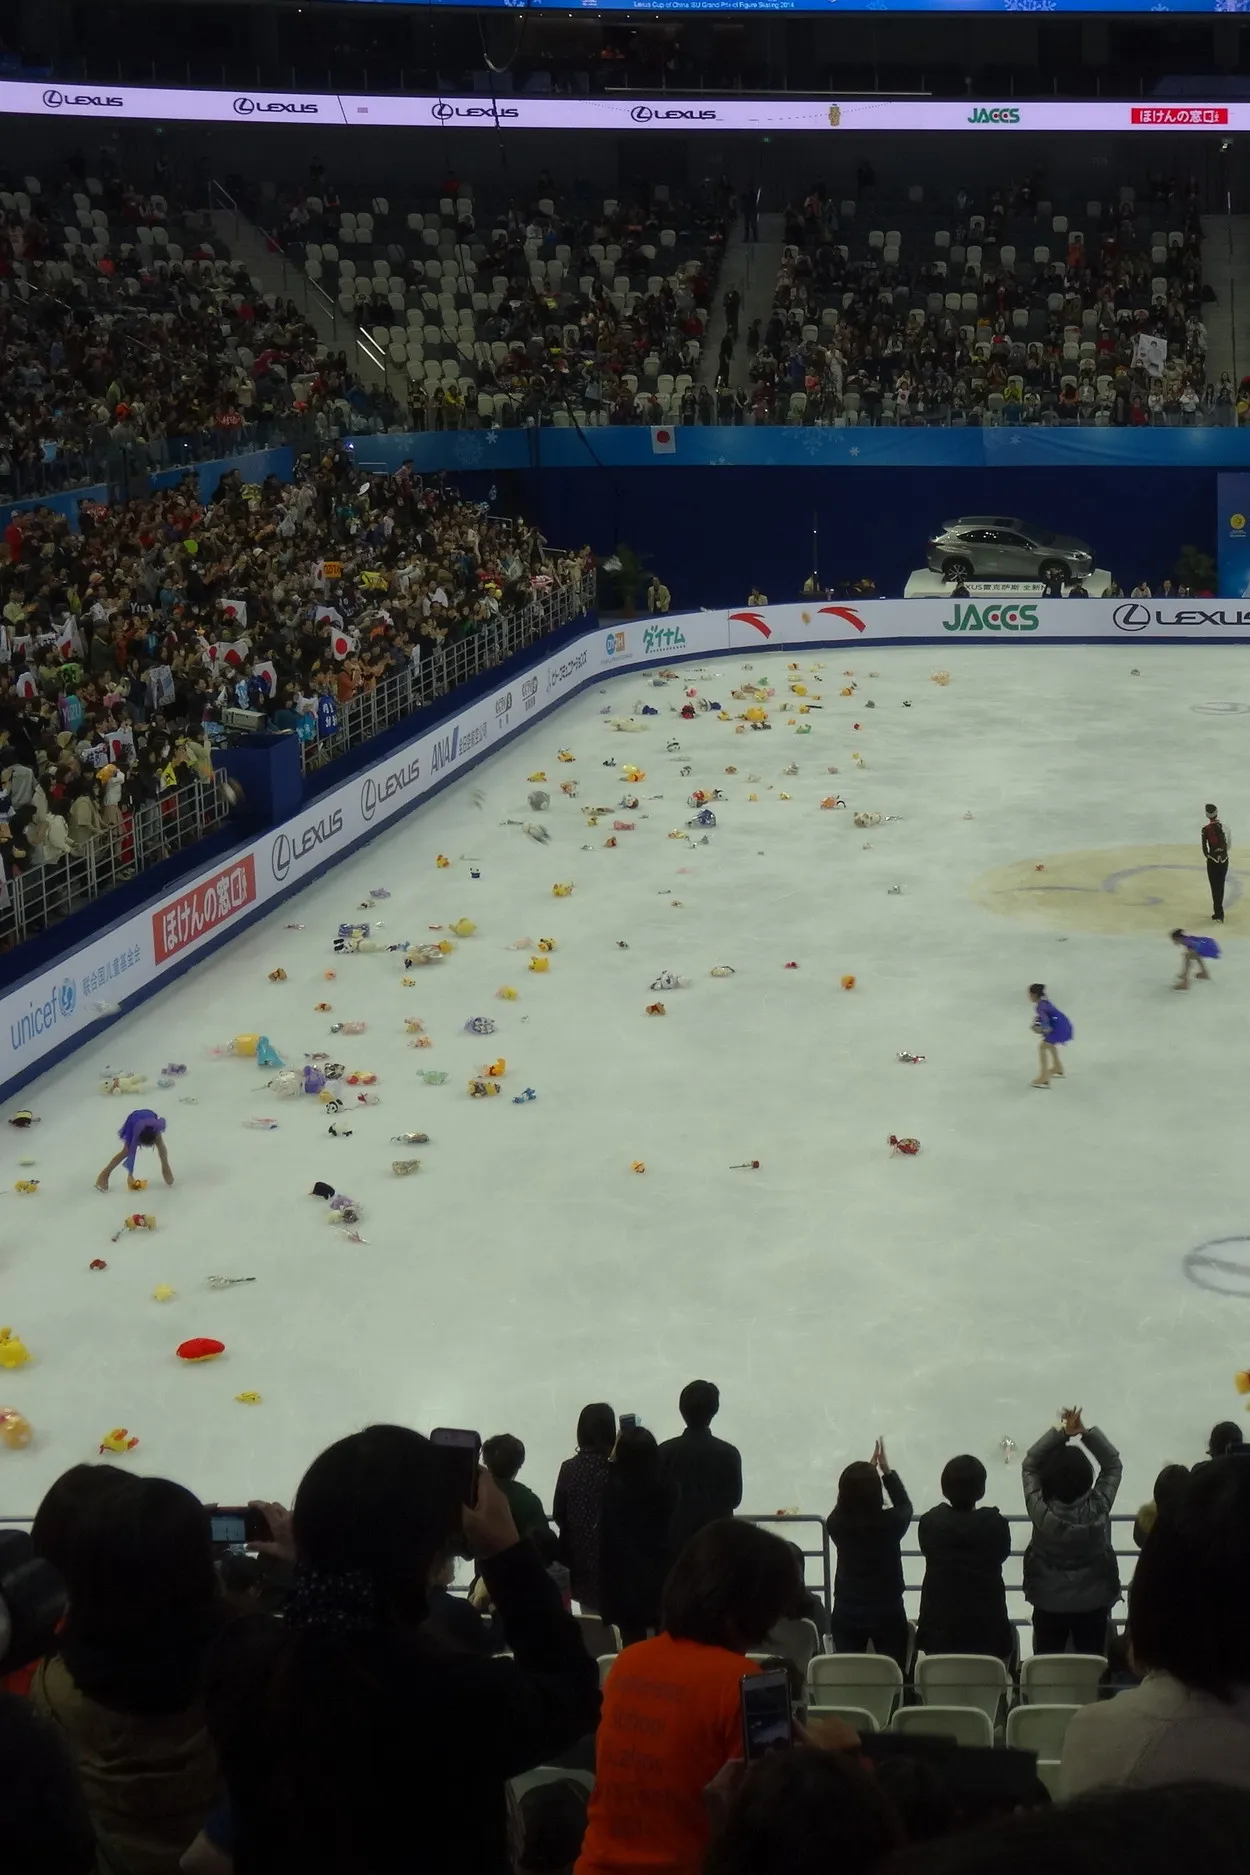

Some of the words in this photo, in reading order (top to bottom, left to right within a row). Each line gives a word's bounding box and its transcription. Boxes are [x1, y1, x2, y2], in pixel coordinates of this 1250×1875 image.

[65, 95, 123, 107] LEXUS
[256, 102, 318, 114] LEXUS
[455, 107, 519, 118] LEXUS
[654, 110, 716, 119] LEXUS
[967, 108, 1020, 124] JACCS
[1140, 110, 1215, 123] ほけんの窓口
[942, 603, 1039, 631] JACCS
[643, 625, 686, 654] ダイナム
[431, 736, 450, 776] ANA
[377, 759, 420, 803] LEXUS
[293, 808, 342, 860] LEXUS
[163, 868, 243, 953] ほけんの窓口
[10, 985, 58, 1051] unicef
